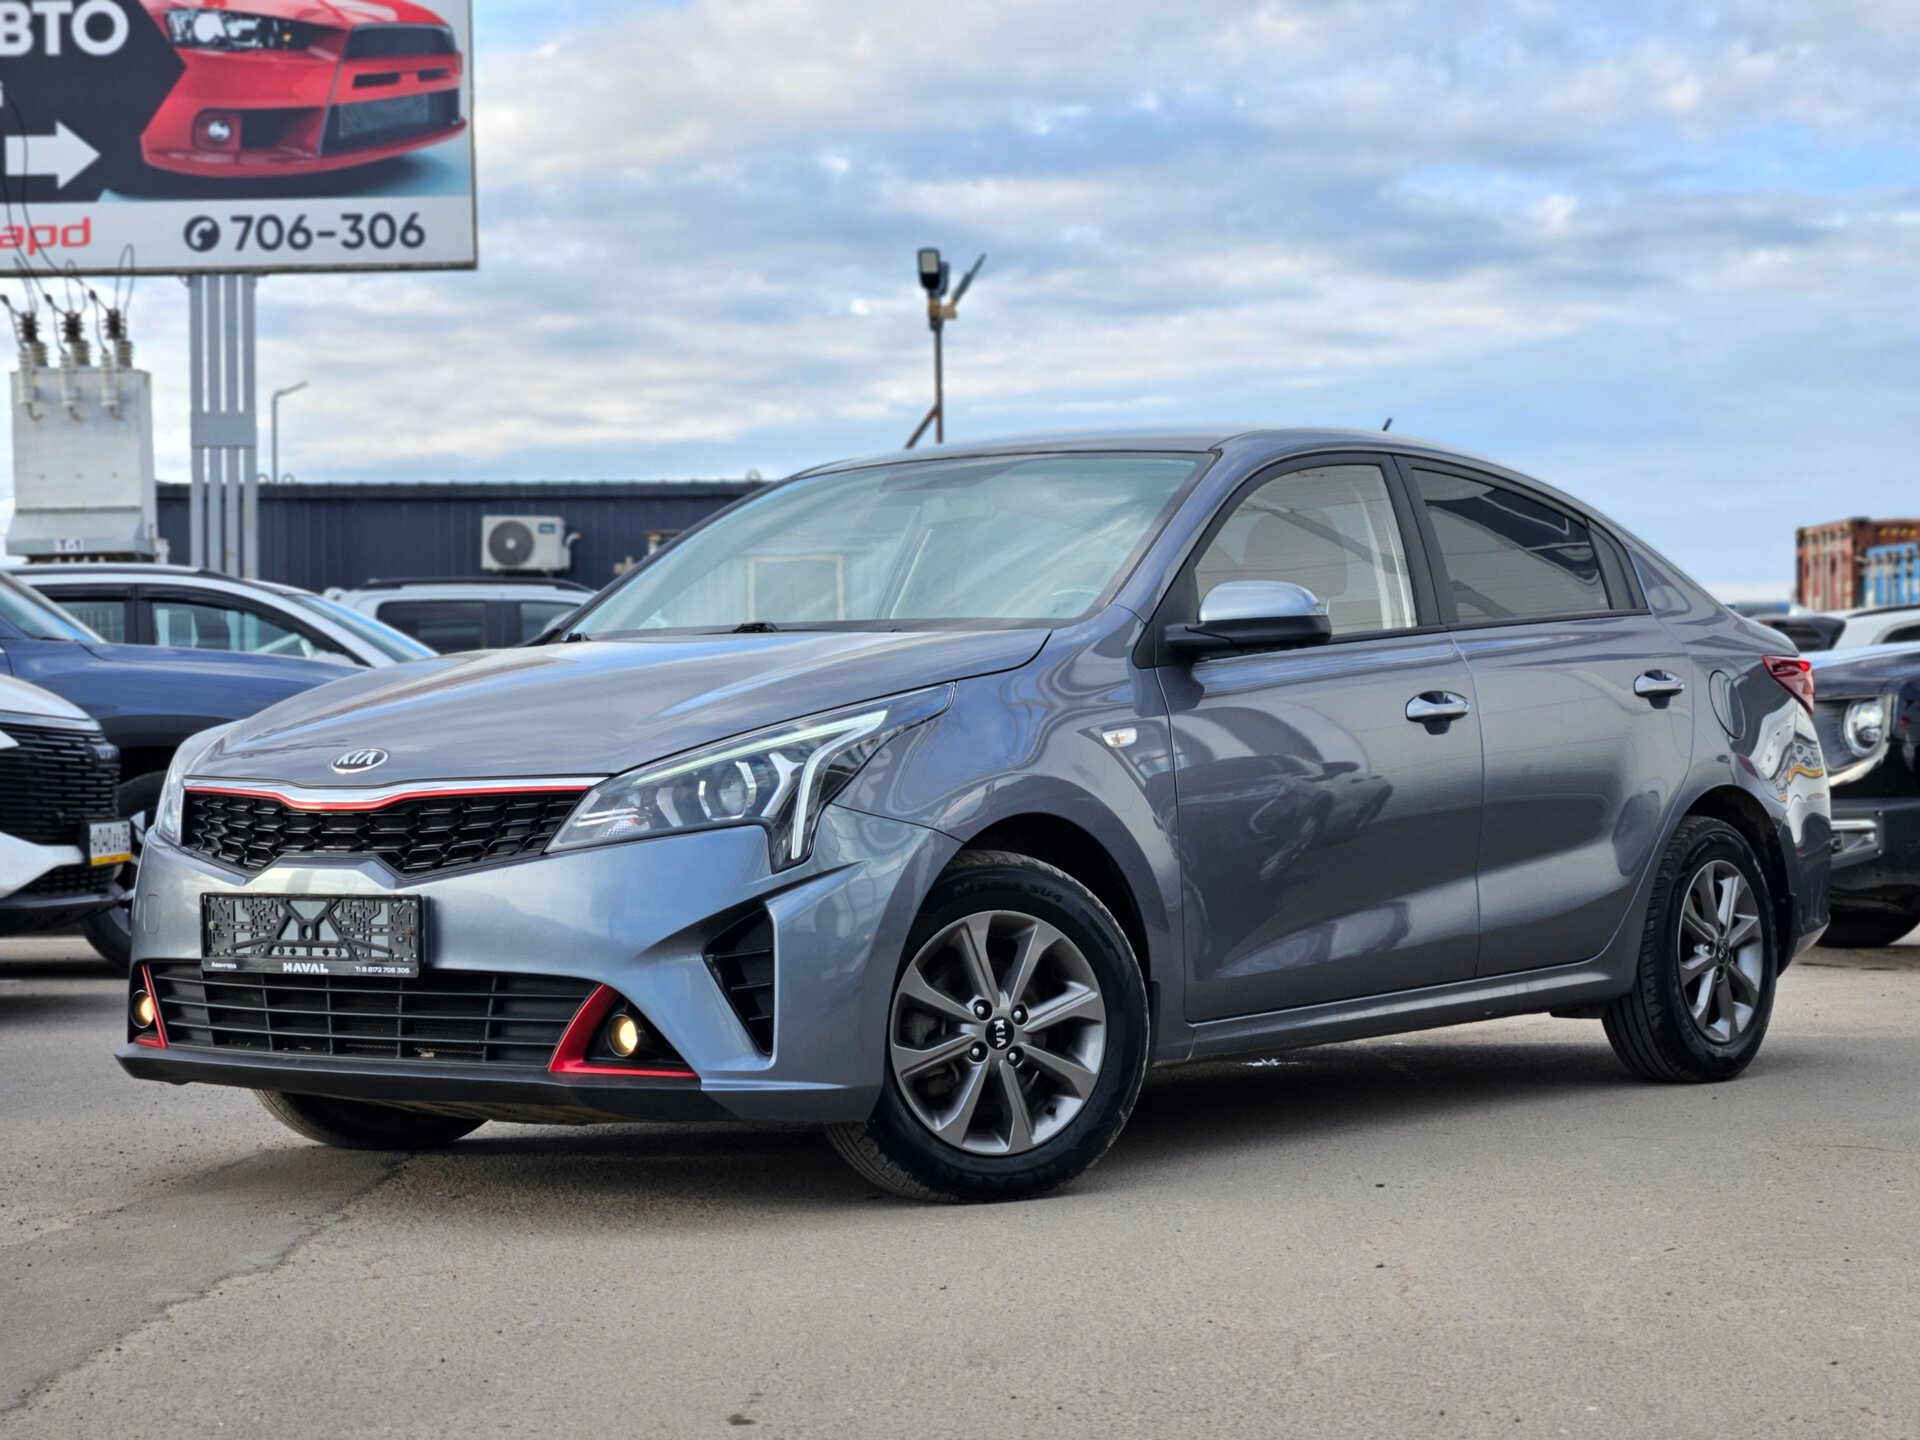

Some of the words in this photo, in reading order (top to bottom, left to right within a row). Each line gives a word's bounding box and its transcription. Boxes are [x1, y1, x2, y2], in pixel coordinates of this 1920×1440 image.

[0, 0, 129, 56] ВТО
[230, 212, 426, 251] 706-306
[335, 751, 378, 766] KIA
[283, 962, 329, 973] HAVAL
[994, 1019, 1007, 1048] KIA
